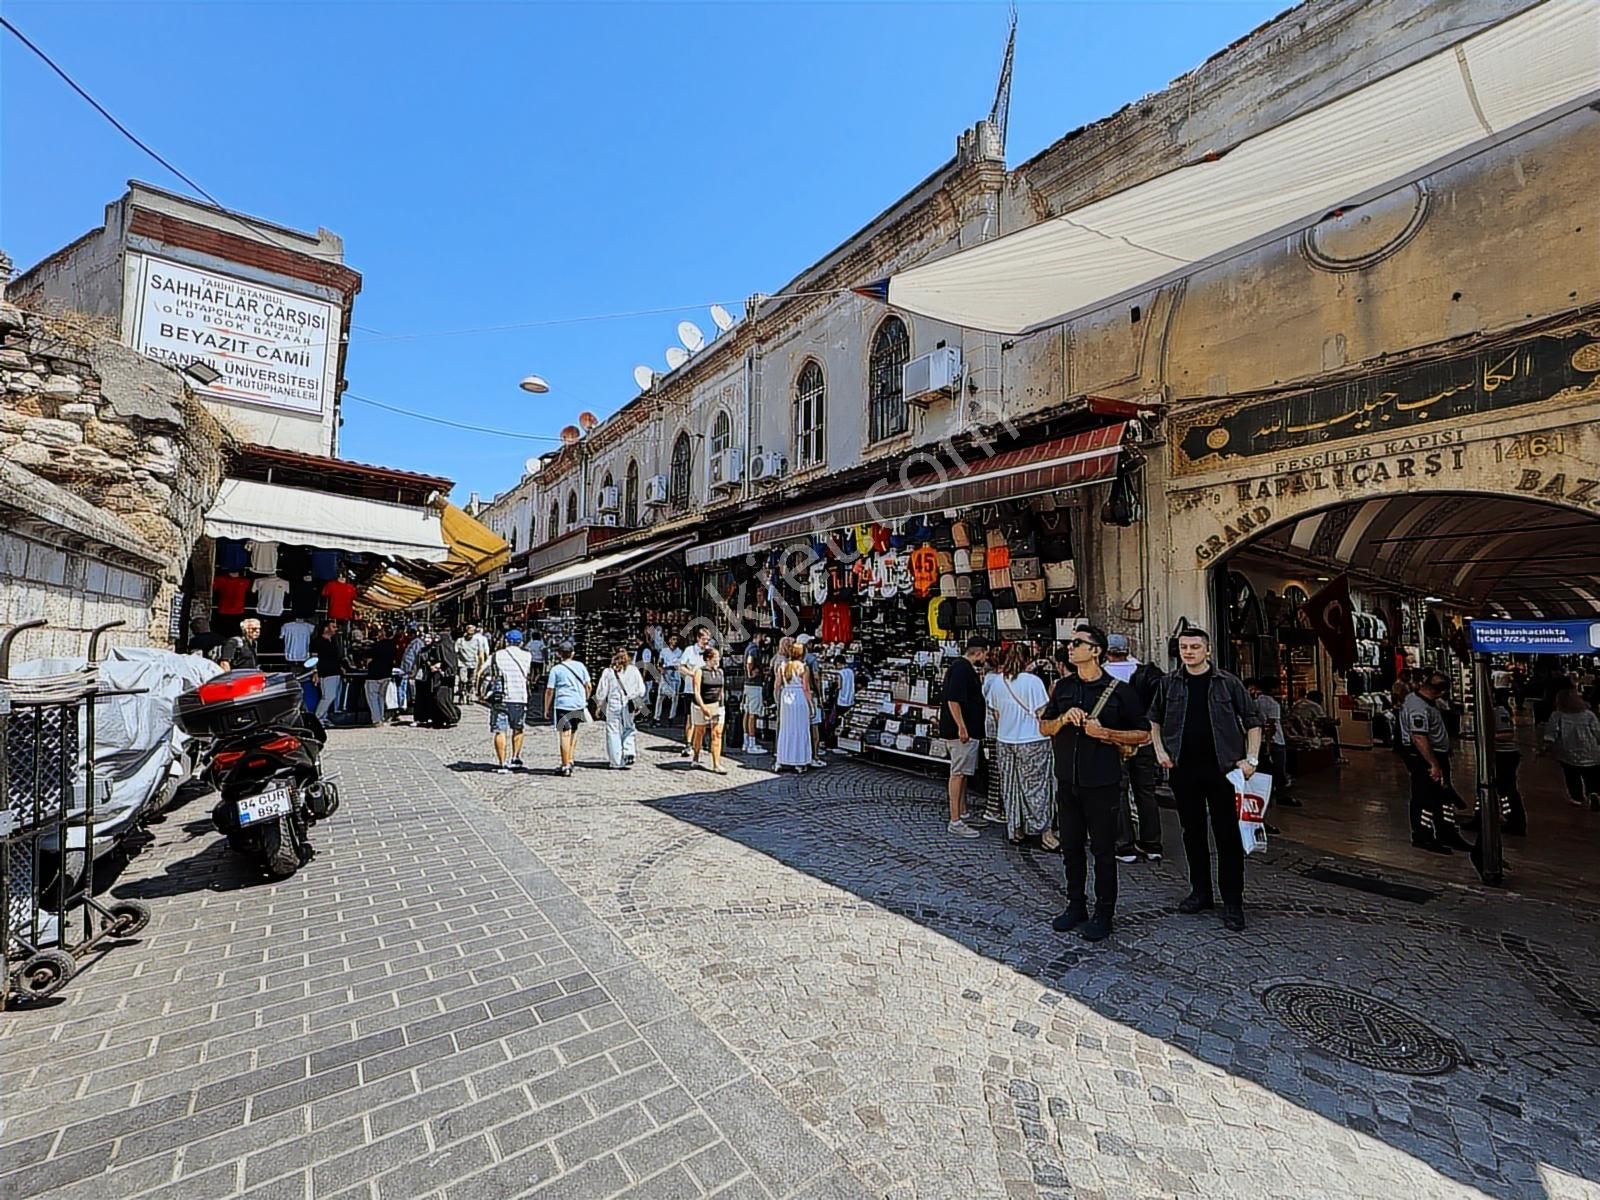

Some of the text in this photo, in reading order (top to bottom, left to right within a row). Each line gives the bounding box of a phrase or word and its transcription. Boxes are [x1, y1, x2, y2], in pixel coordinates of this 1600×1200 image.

[151, 274, 325, 330] SAHHAFLAR ÇARŞISI
[237, 286, 285, 306] İSTANBUL
[163, 305, 310, 346] OLD BOOK BAZAAR
[160, 323, 310, 368] BEYAZIT CAMİİ
[225, 360, 319, 391] ÜNİVERSİTESİ
[1383, 429, 1464, 454] KAPISI
[1493, 432, 1565, 463] 1461
[1195, 505, 1272, 560] GRAND
[915, 553, 935, 573] 45
[240, 800, 256, 811] 34
